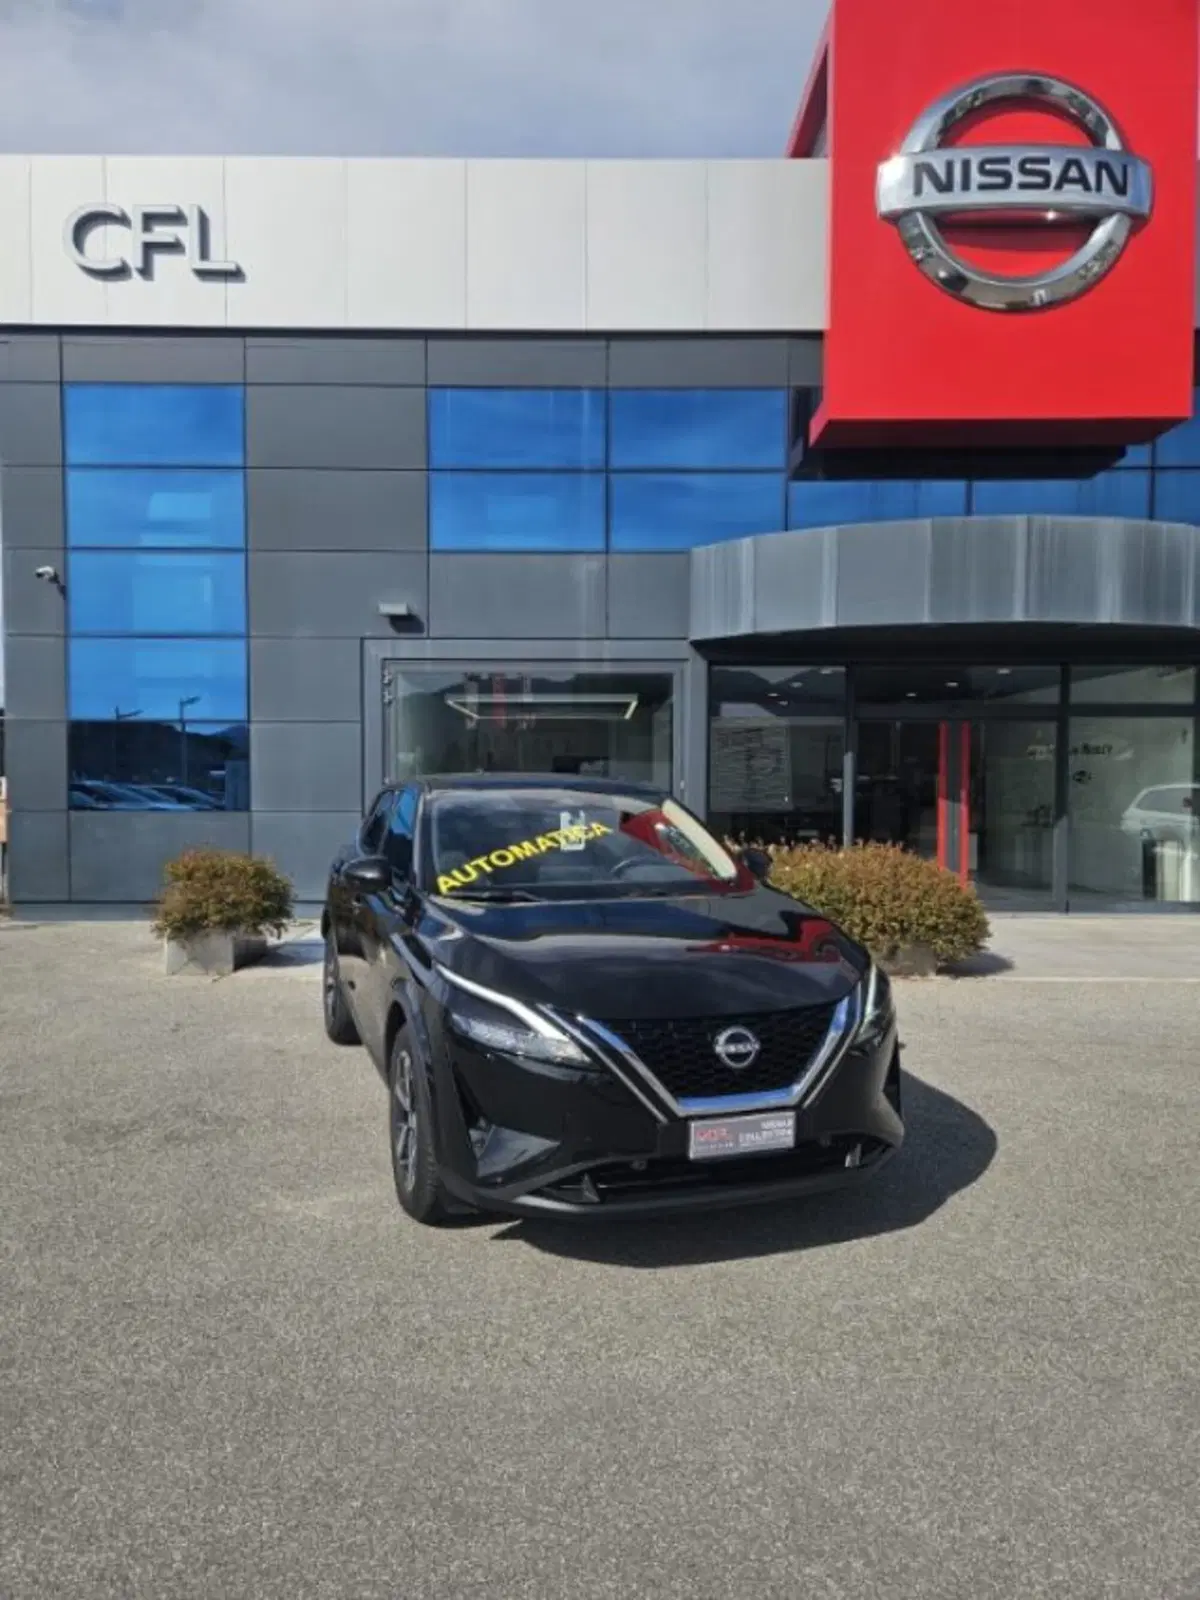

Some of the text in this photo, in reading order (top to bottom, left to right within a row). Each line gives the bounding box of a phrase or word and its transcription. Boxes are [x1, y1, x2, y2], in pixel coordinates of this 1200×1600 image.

[913, 156, 1128, 197] NISSAN
[63, 203, 245, 281] CFL
[436, 821, 613, 895] AUTOMATICA
